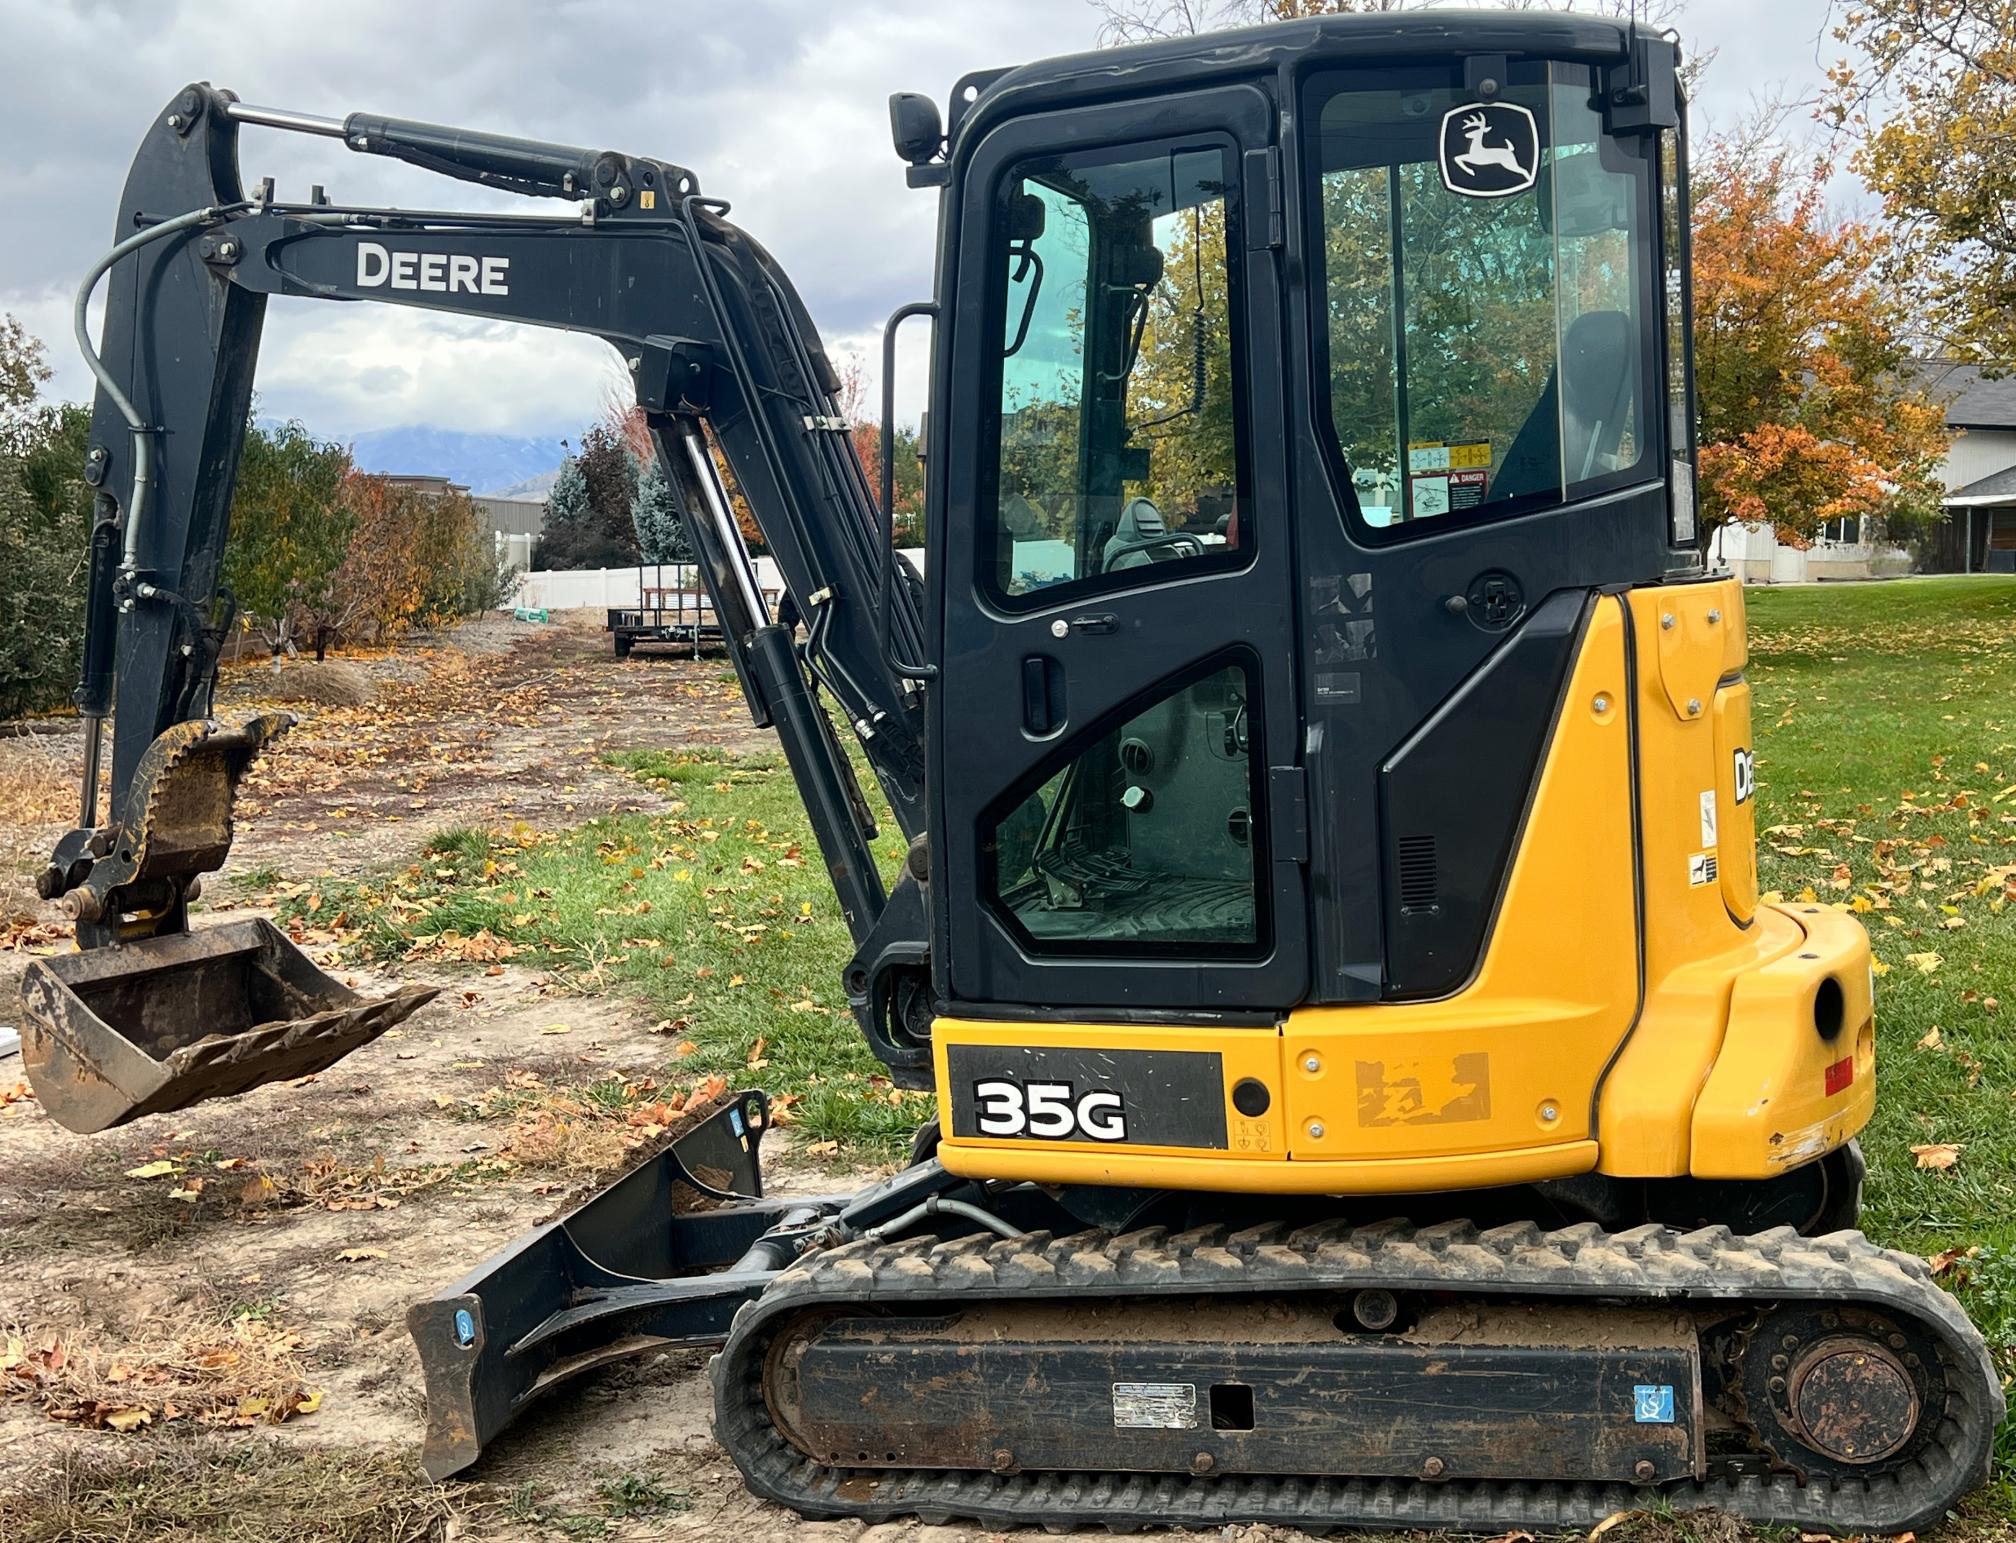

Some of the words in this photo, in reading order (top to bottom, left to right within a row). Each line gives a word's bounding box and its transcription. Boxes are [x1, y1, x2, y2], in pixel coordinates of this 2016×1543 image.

[356, 242, 510, 296] DEERE
[1461, 473, 1484, 483] DANGER
[976, 1080, 1126, 1140] 35G
